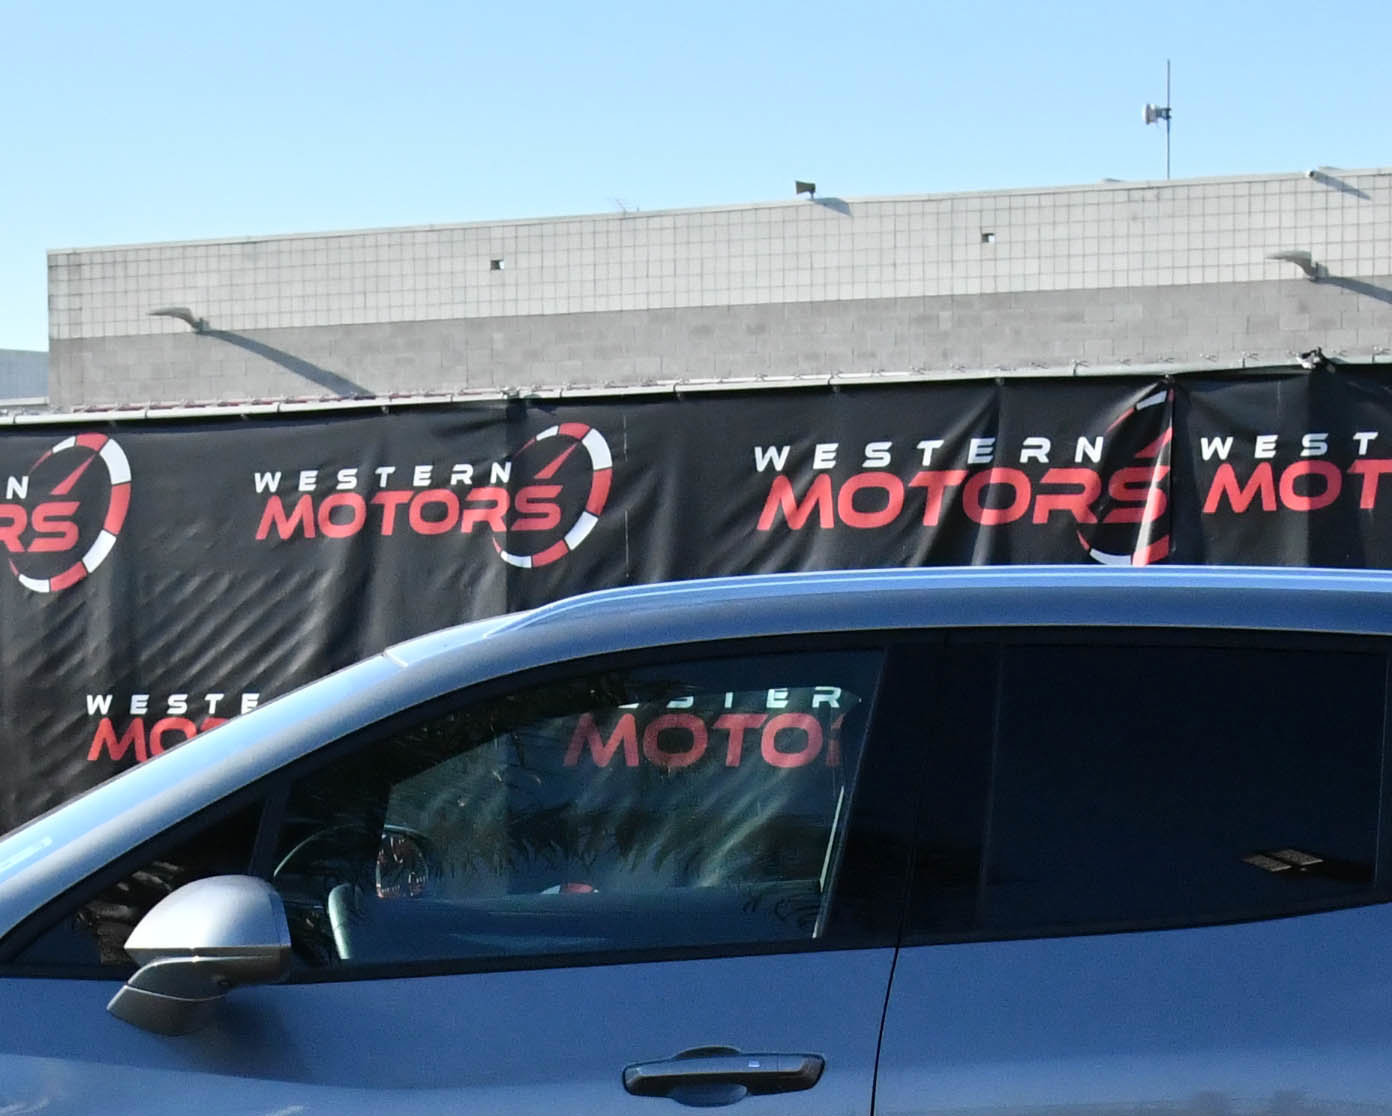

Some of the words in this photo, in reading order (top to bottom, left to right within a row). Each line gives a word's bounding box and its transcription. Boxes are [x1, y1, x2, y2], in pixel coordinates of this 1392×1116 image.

[254, 461, 512, 493] WESTERN
[754, 436, 1105, 472] WESTERN
[255, 484, 566, 540] MOTORS
[756, 464, 1168, 532] MOTORS
[86, 692, 261, 716] WESTE
[562, 712, 847, 768] MOTO
